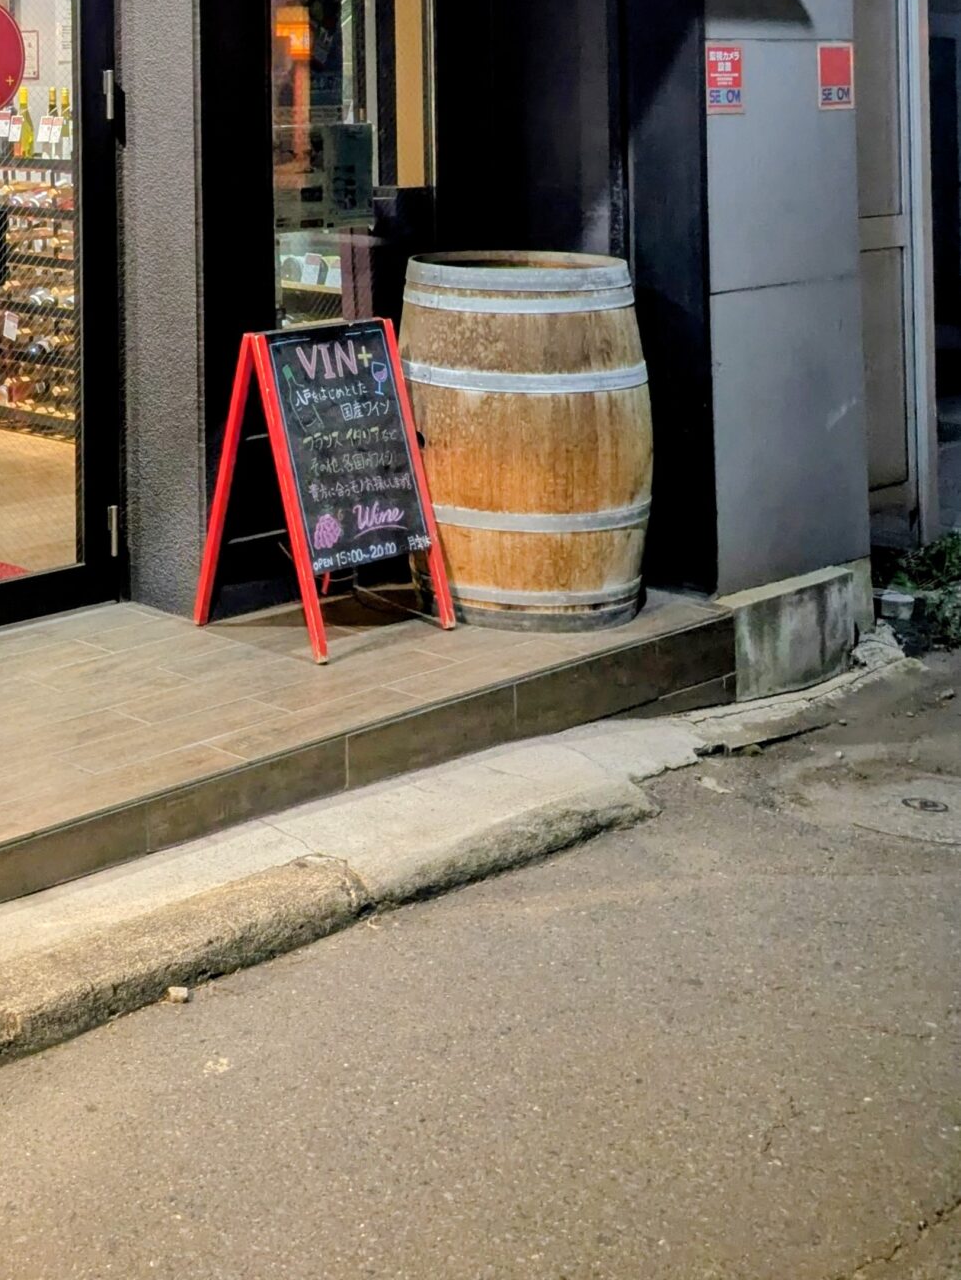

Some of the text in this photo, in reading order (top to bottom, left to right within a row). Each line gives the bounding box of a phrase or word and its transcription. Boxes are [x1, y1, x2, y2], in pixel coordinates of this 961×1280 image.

[295, 381, 369, 407] 八戸をはじめとした
[340, 400, 390, 421] 国産ワイン
[352, 501, 405, 530] Wine
[313, 558, 334, 571] OPEN
